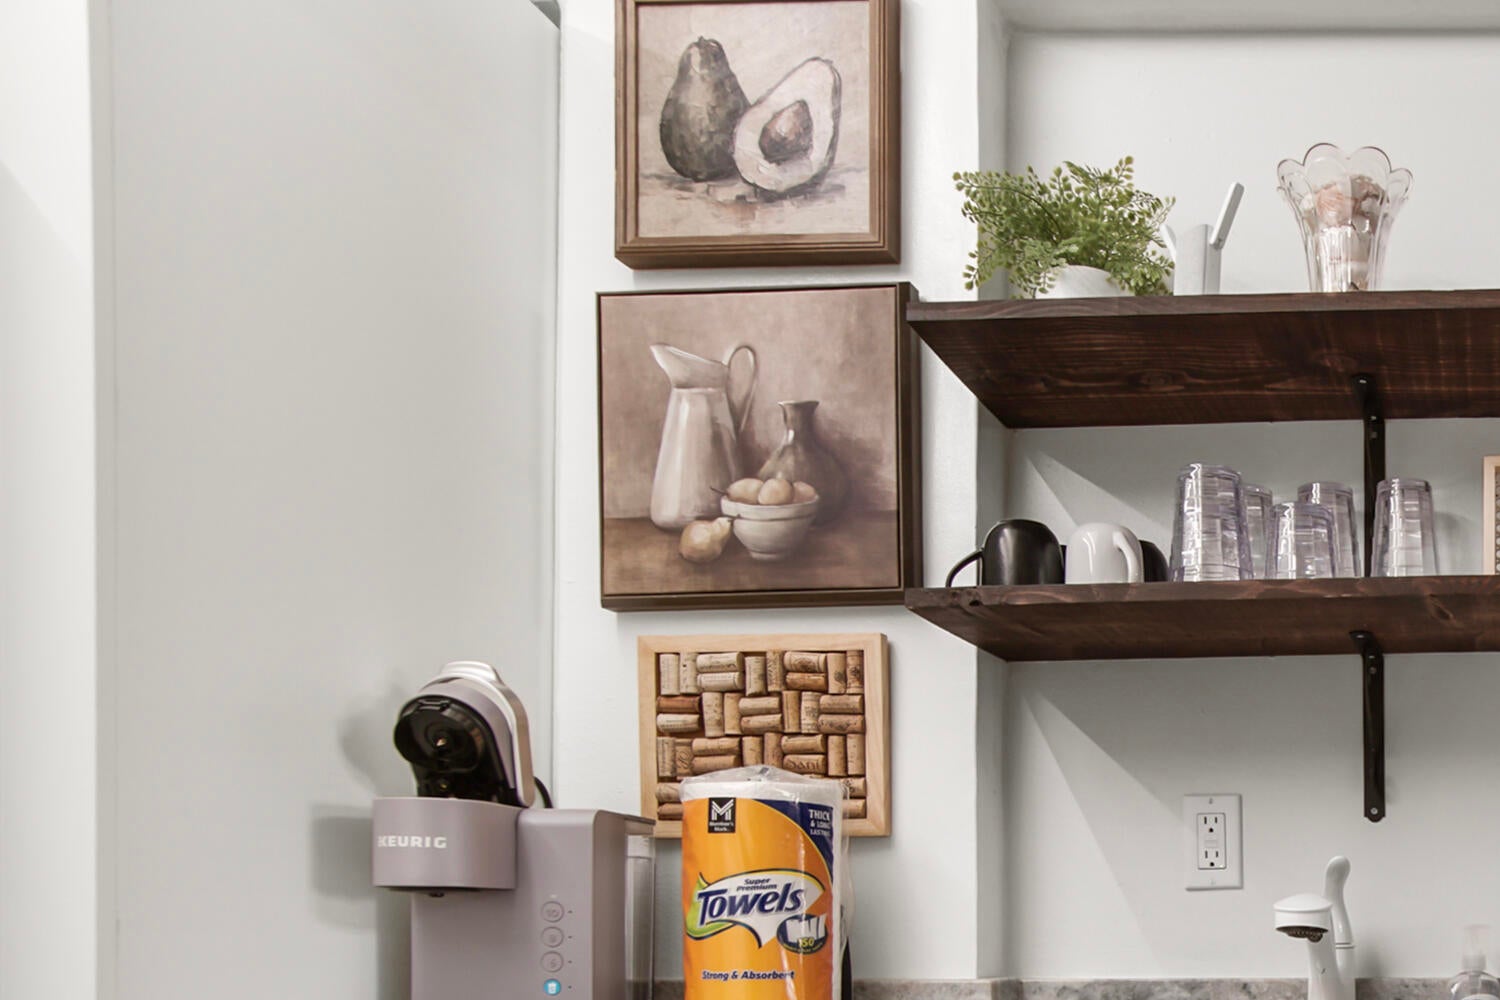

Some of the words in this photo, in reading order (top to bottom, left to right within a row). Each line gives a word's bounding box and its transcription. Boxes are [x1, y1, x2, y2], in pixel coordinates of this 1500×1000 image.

[809, 809, 830, 820] THICK
[377, 835, 447, 849] KEURIG
[697, 882, 804, 926] Towels
[702, 969, 729, 982] Strong
[731, 971, 739, 980] &
